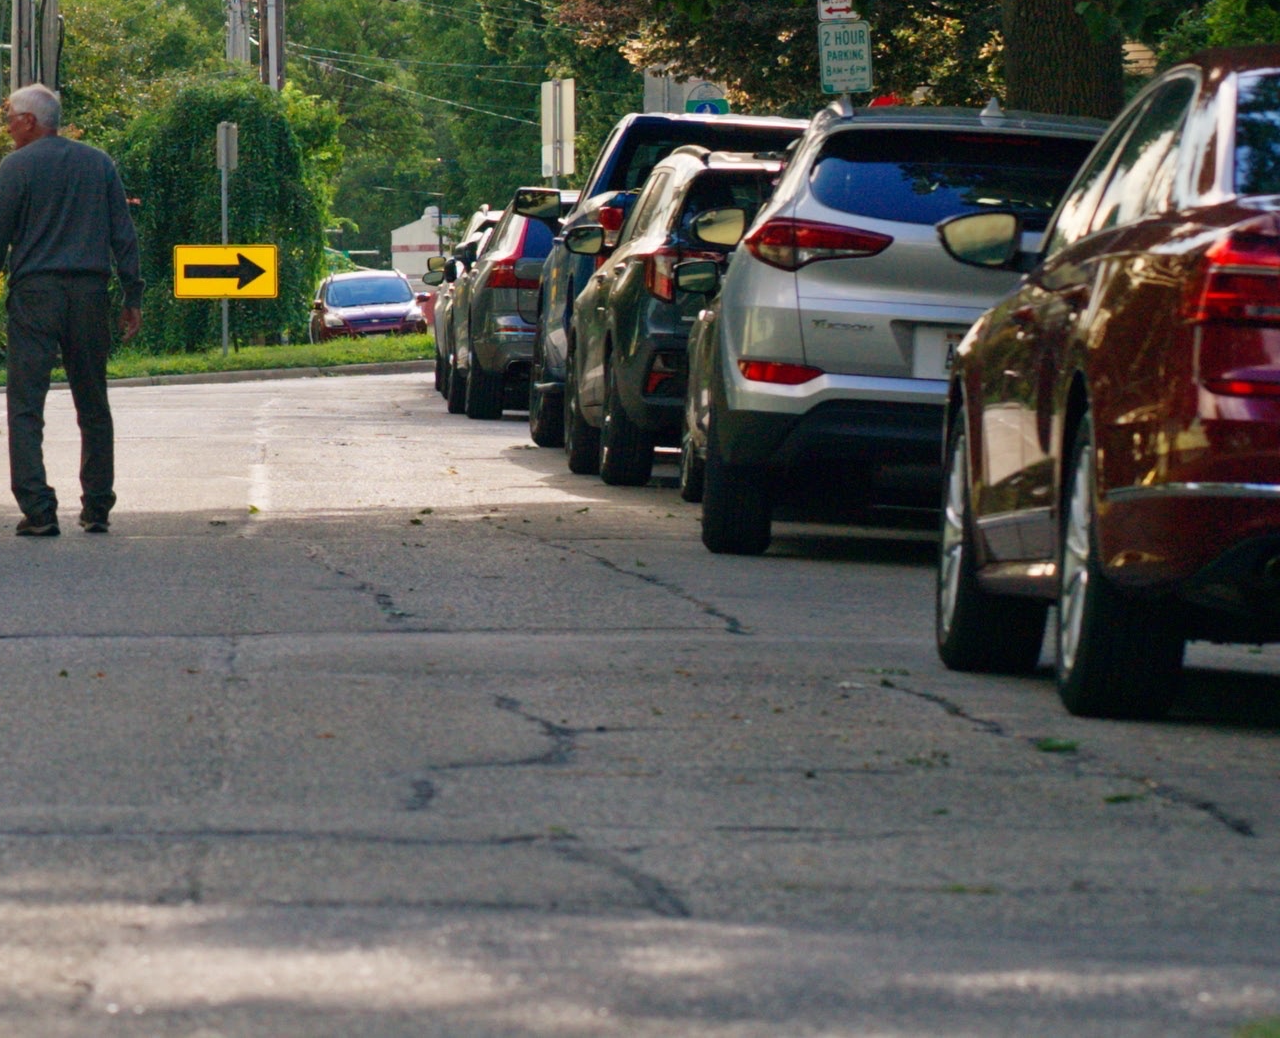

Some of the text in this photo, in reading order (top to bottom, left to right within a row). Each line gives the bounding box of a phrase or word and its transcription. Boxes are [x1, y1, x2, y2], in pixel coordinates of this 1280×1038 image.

[823, 30, 865, 46] 2 HOUR
[827, 49, 864, 61] PARKING
